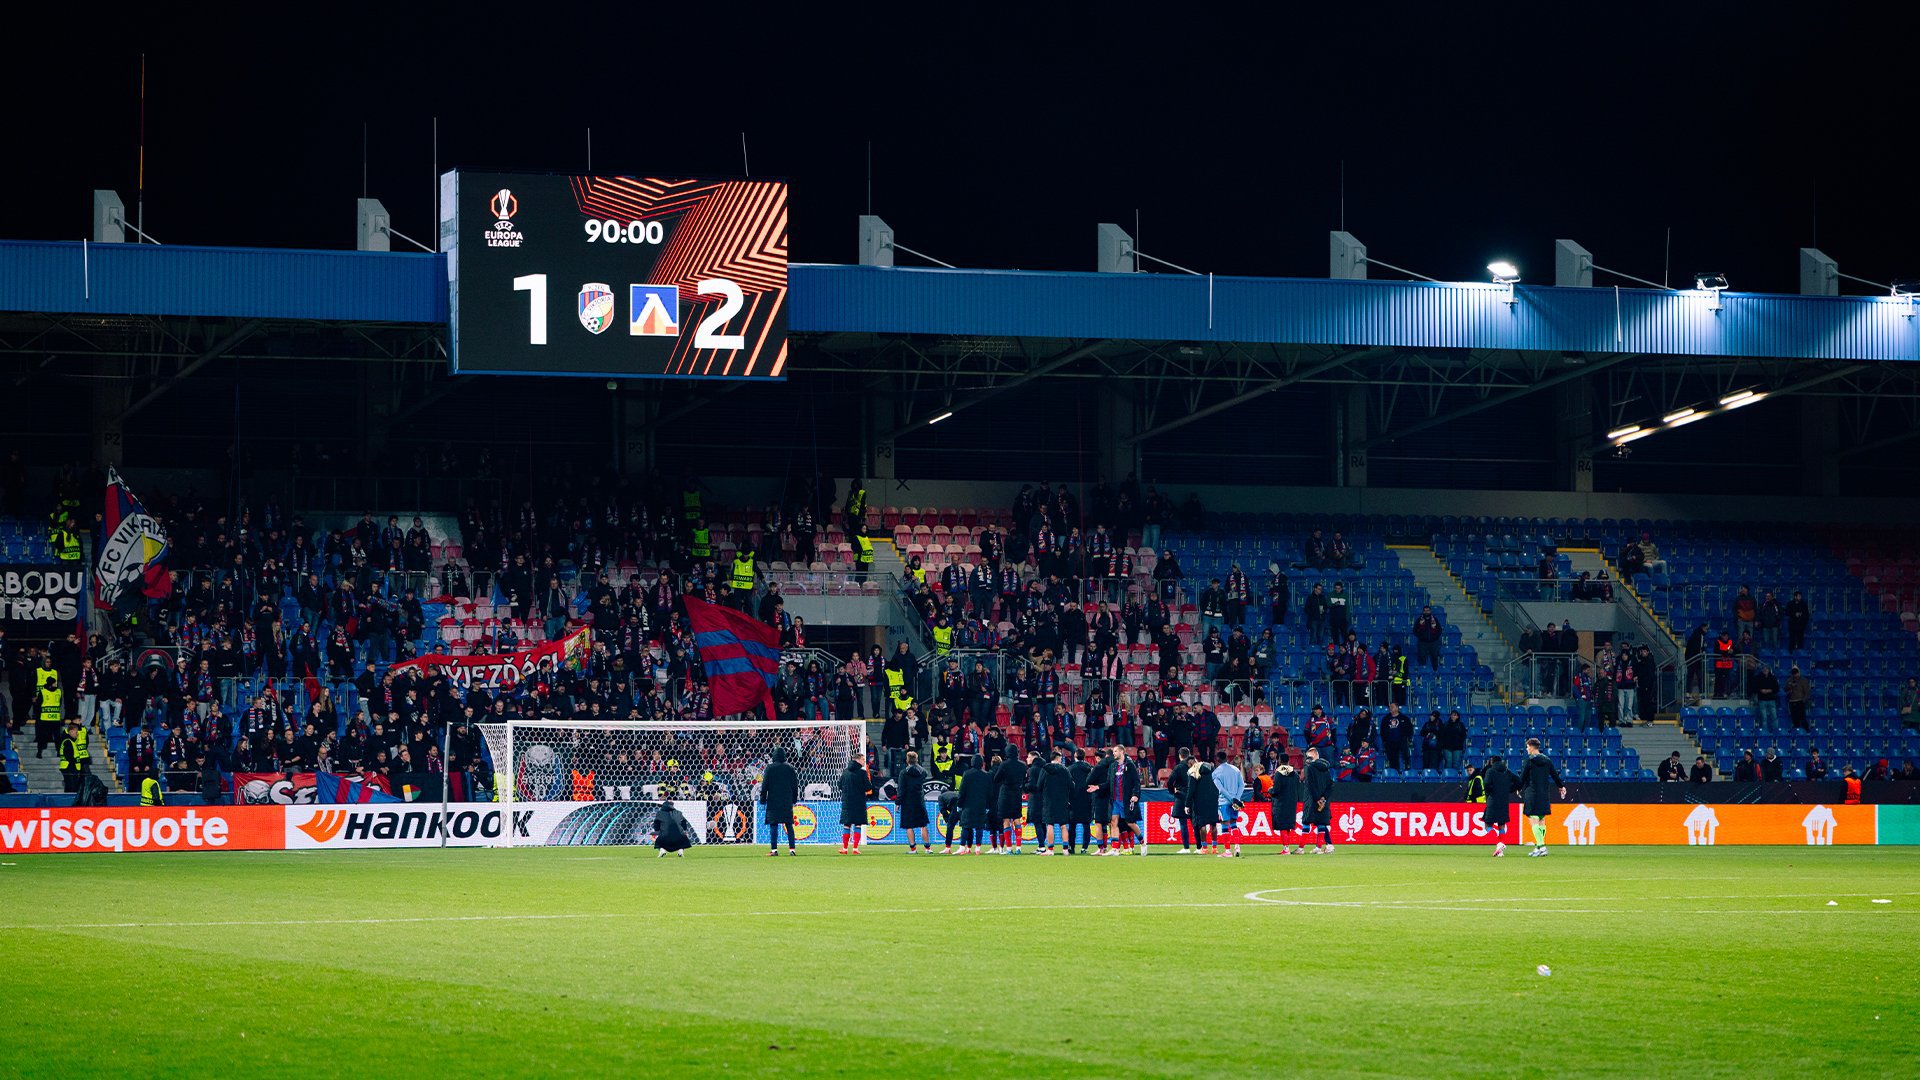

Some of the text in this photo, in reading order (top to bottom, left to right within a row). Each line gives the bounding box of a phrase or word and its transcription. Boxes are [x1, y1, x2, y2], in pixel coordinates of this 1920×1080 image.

[485, 231, 523, 240] EUROPA
[585, 219, 664, 244] 90:00
[514, 274, 547, 345] 1
[694, 279, 745, 350] 2
[877, 446, 891, 458] P3
[1351, 455, 1365, 467] R4
[1578, 461, 1591, 472] R4
[102, 549, 121, 574] FC
[0, 571, 83, 595] BODU
[0, 809, 228, 852] wissquote
